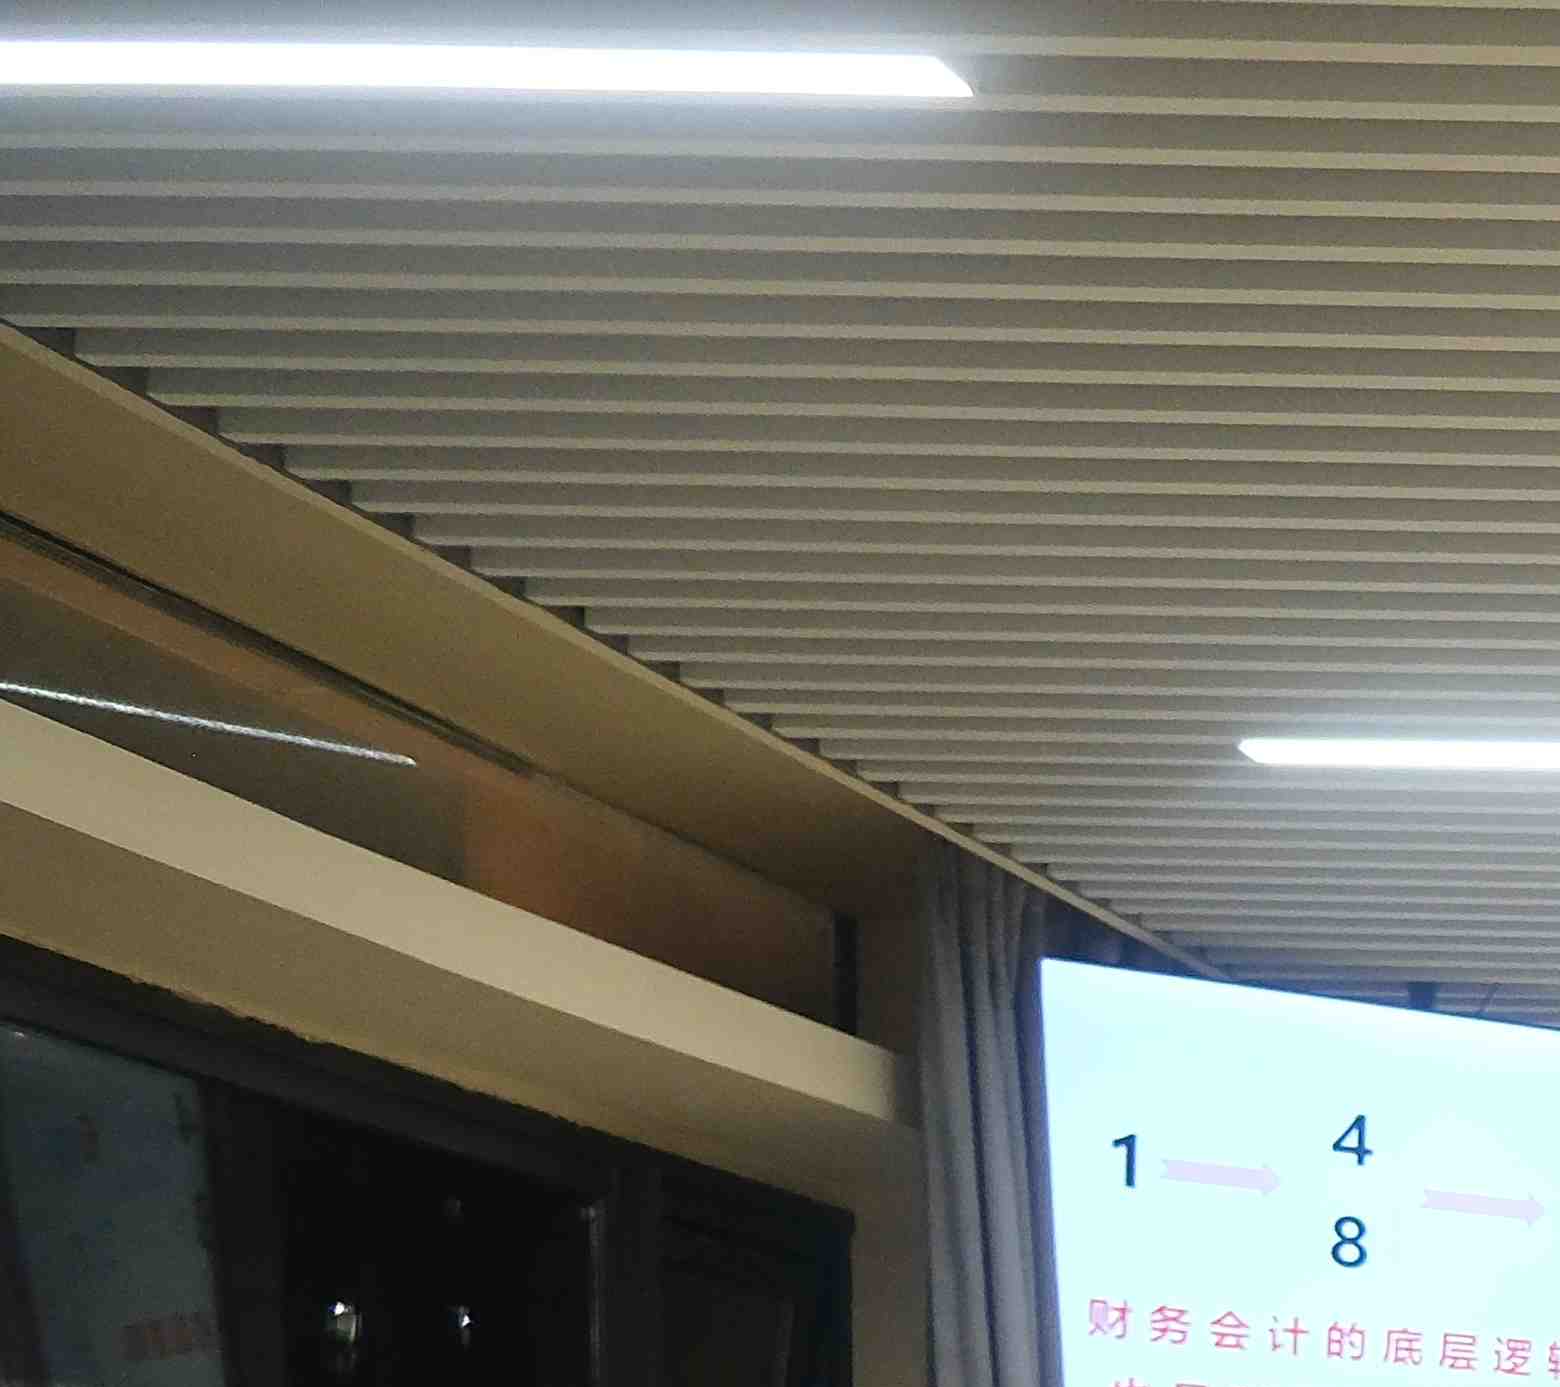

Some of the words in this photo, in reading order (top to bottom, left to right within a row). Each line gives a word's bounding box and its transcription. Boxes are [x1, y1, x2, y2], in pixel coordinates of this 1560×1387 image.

[1111, 1133, 1138, 1189] 1
[1331, 1114, 1374, 1167] 4
[1330, 1215, 1369, 1269] 8
